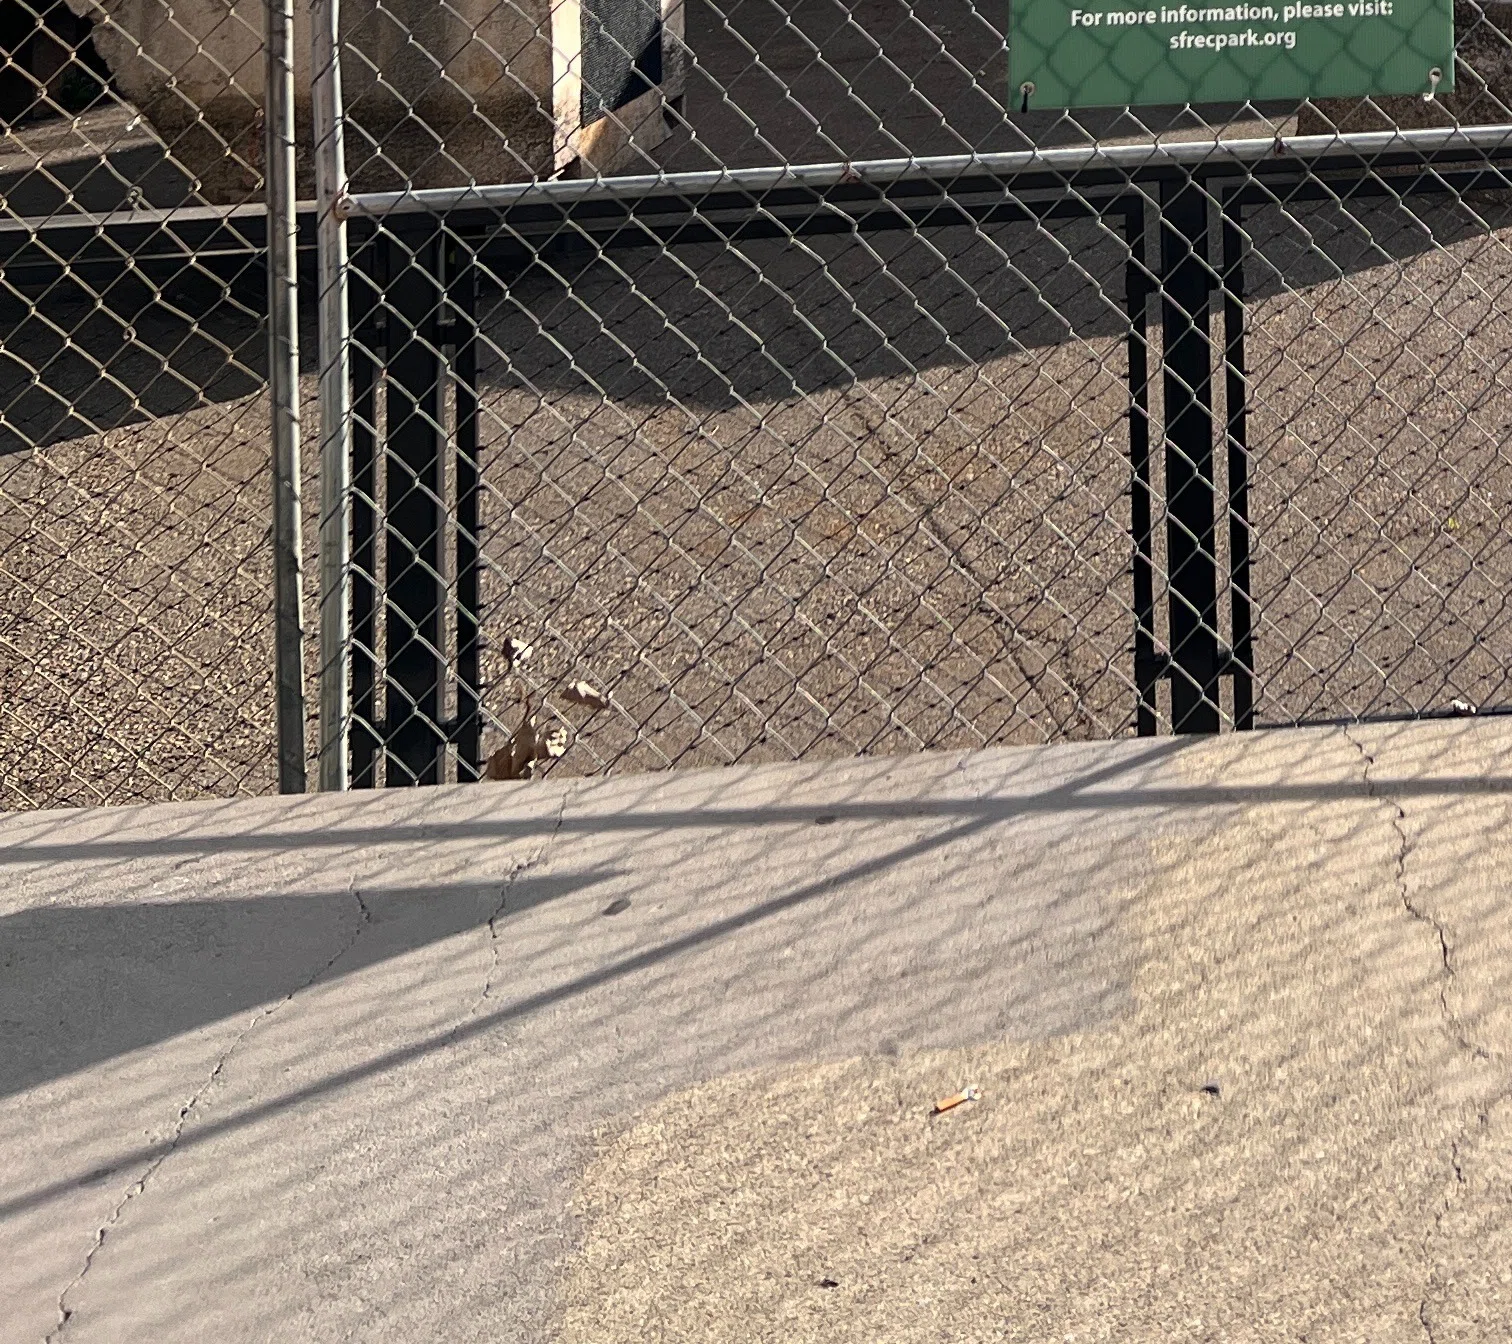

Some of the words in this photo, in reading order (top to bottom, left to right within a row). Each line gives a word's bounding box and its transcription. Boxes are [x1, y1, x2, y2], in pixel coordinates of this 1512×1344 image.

[1072, 9, 1104, 27] For
[1106, 10, 1157, 26] more
[1161, 3, 1279, 24] information,
[1283, 0, 1345, 22] please
[1170, 29, 1296, 52] sfrecpark.org
